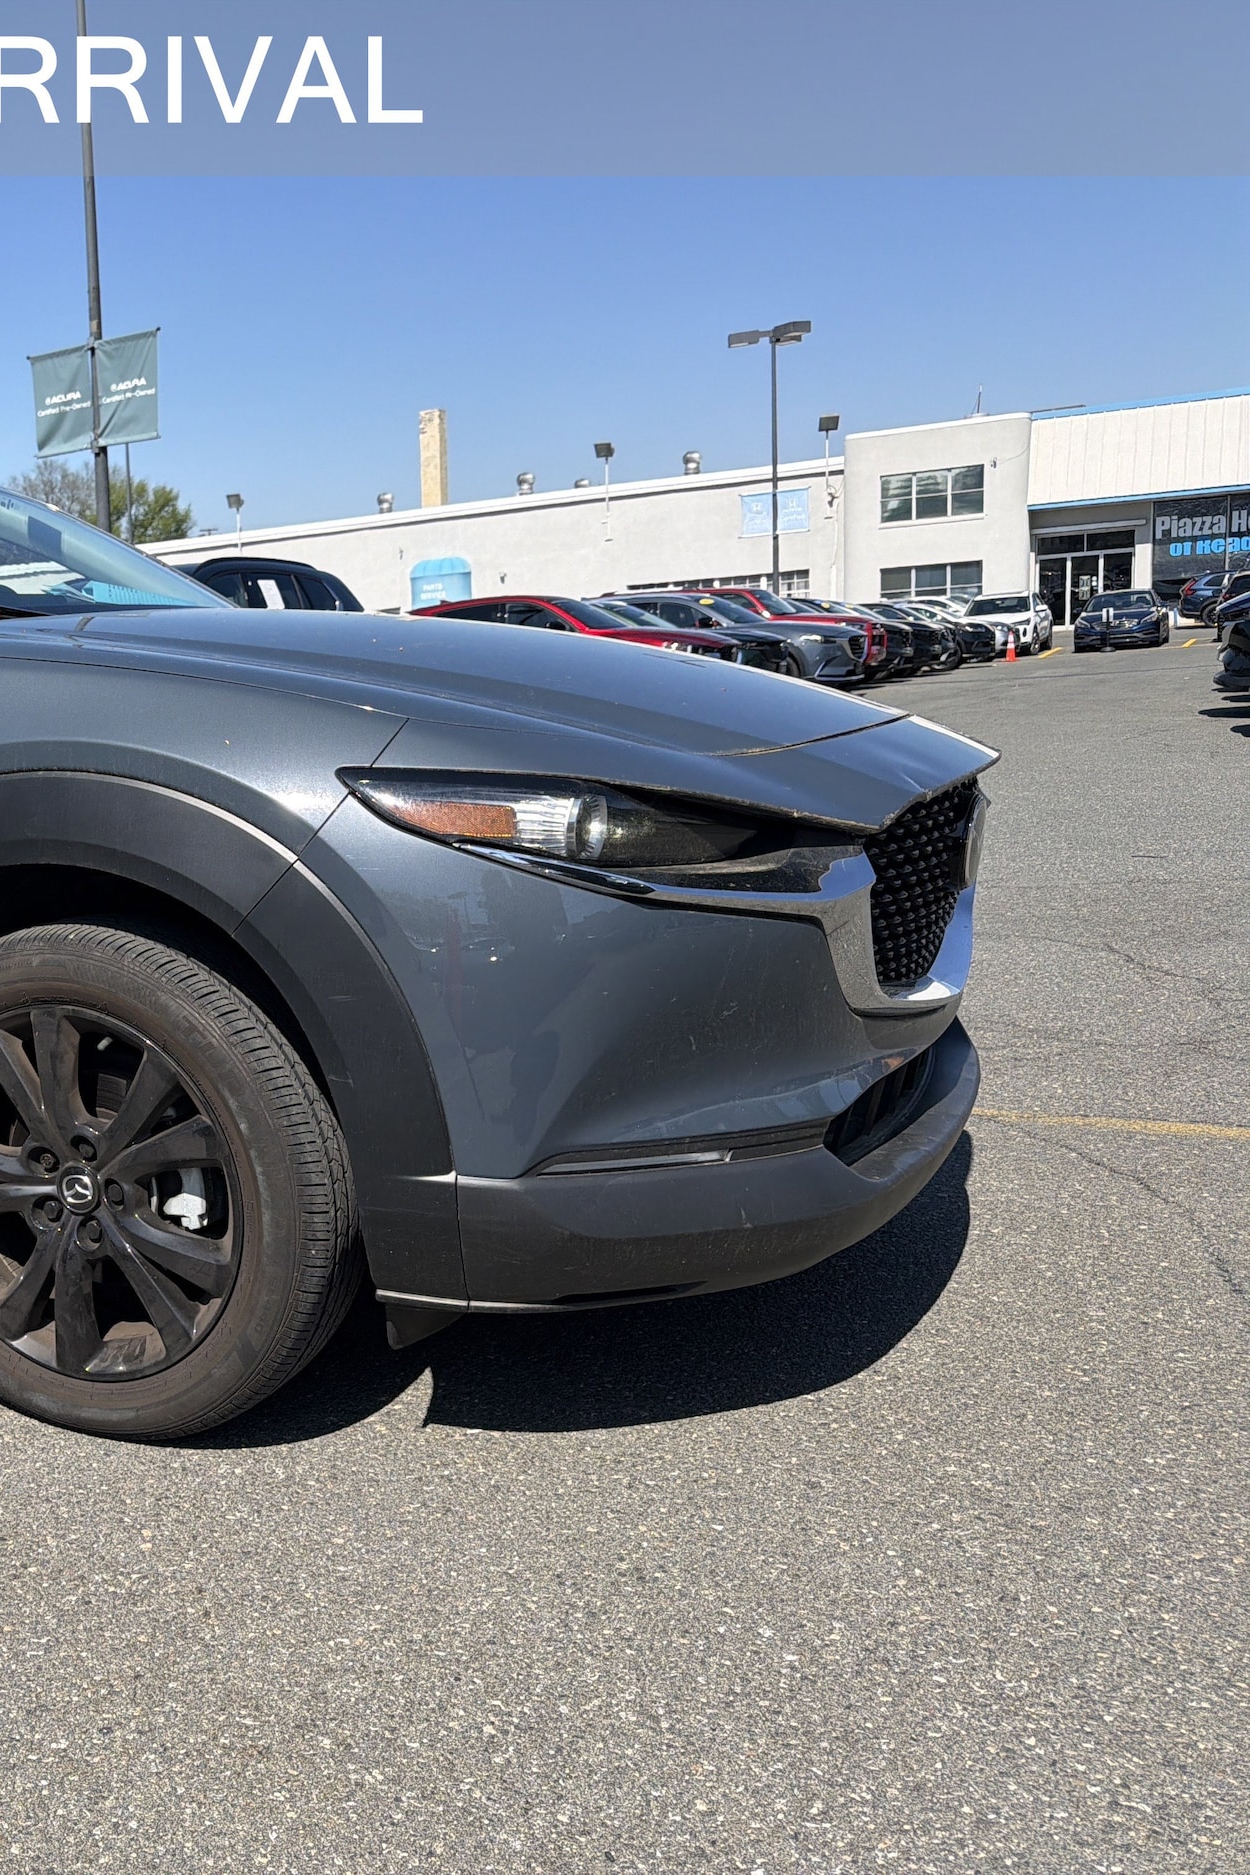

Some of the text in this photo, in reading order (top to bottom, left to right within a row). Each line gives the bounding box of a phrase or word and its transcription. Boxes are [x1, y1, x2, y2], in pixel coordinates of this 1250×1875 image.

[116, 377, 147, 391] ACURA
[50, 391, 82, 405] ACURA
[1155, 509, 1250, 540] Piazza H
